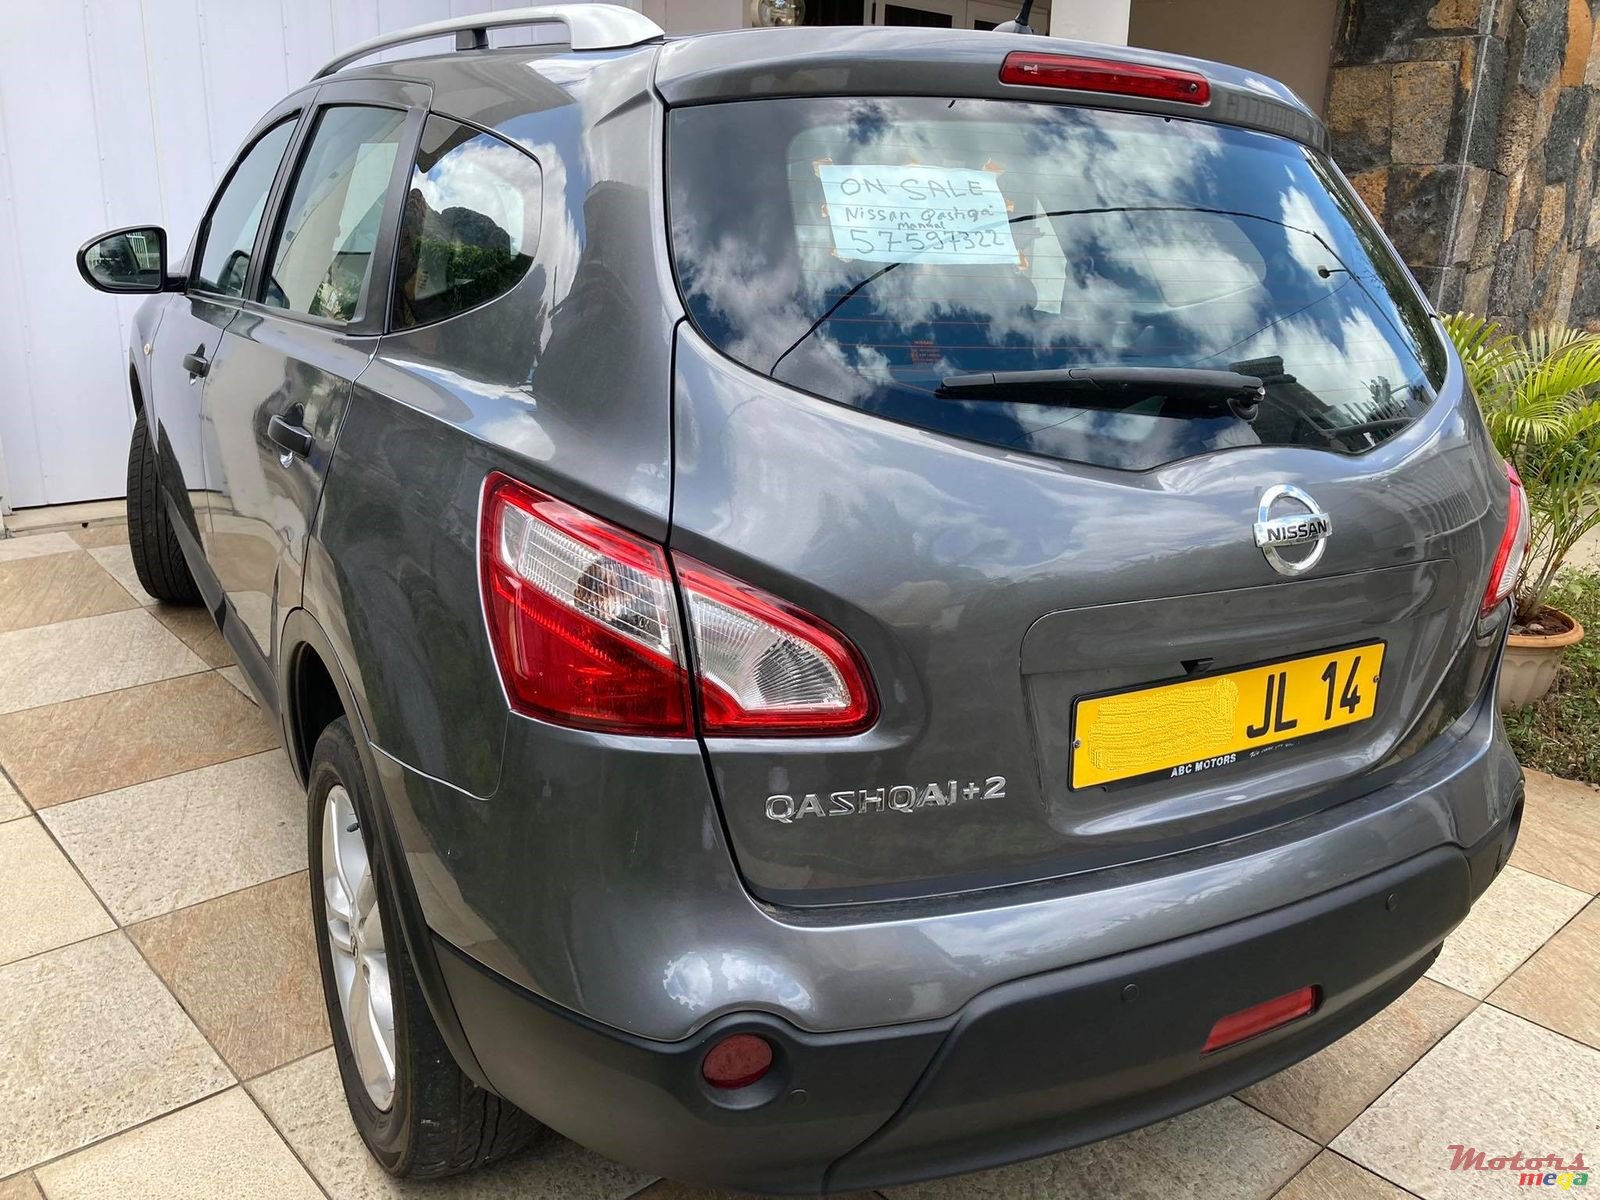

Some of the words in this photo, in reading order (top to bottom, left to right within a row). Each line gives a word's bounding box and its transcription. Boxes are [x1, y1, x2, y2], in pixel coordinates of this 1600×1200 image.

[840, 178, 886, 196] ON
[900, 178, 983, 201] SALE
[845, 207, 911, 222] Nissan
[1267, 519, 1328, 542] NISSAN
[1246, 671, 1297, 739] JL
[1321, 655, 1362, 721] 14
[1170, 764, 1193, 778] ABC
[1195, 753, 1237, 773] MOTORS
